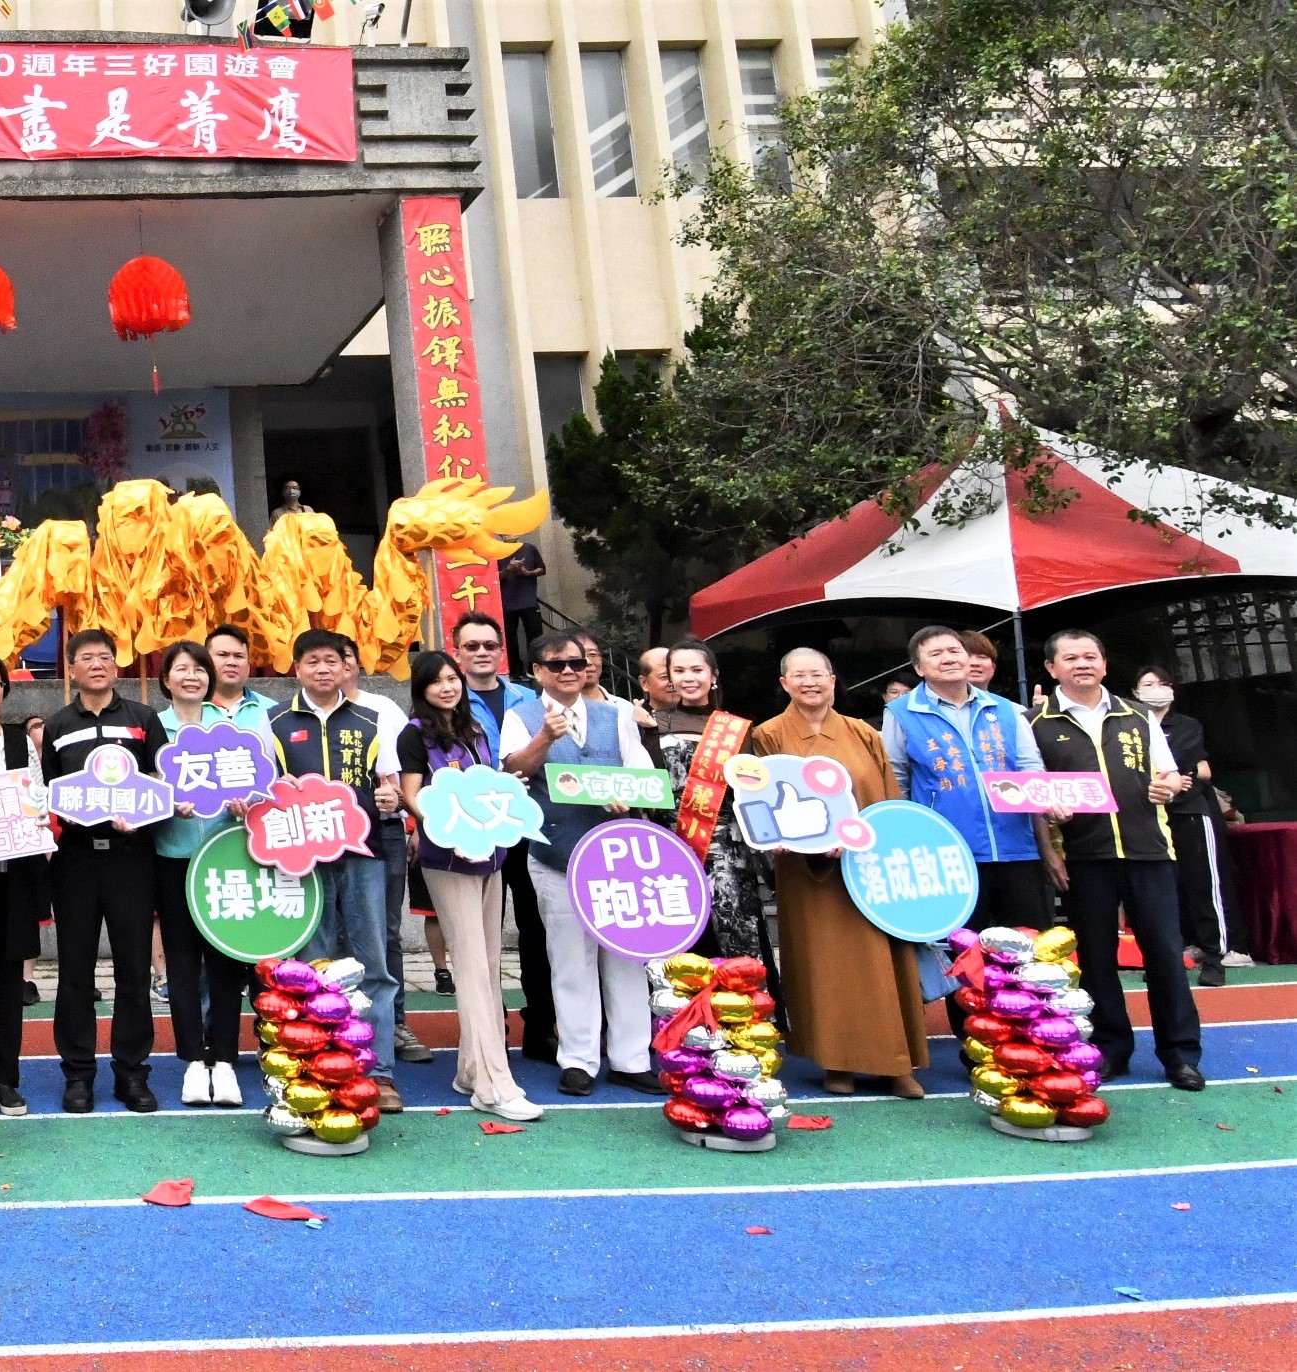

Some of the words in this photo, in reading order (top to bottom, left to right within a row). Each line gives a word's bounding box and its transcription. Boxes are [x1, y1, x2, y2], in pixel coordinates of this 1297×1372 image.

[173, 745, 257, 792] 友善
[58, 786, 164, 815] 聯興國小
[261, 798, 346, 850] 創新
[442, 788, 525, 834] 人文
[601, 835, 661, 872] PU
[204, 867, 306, 921] 操場
[587, 874, 697, 930] 跑道
